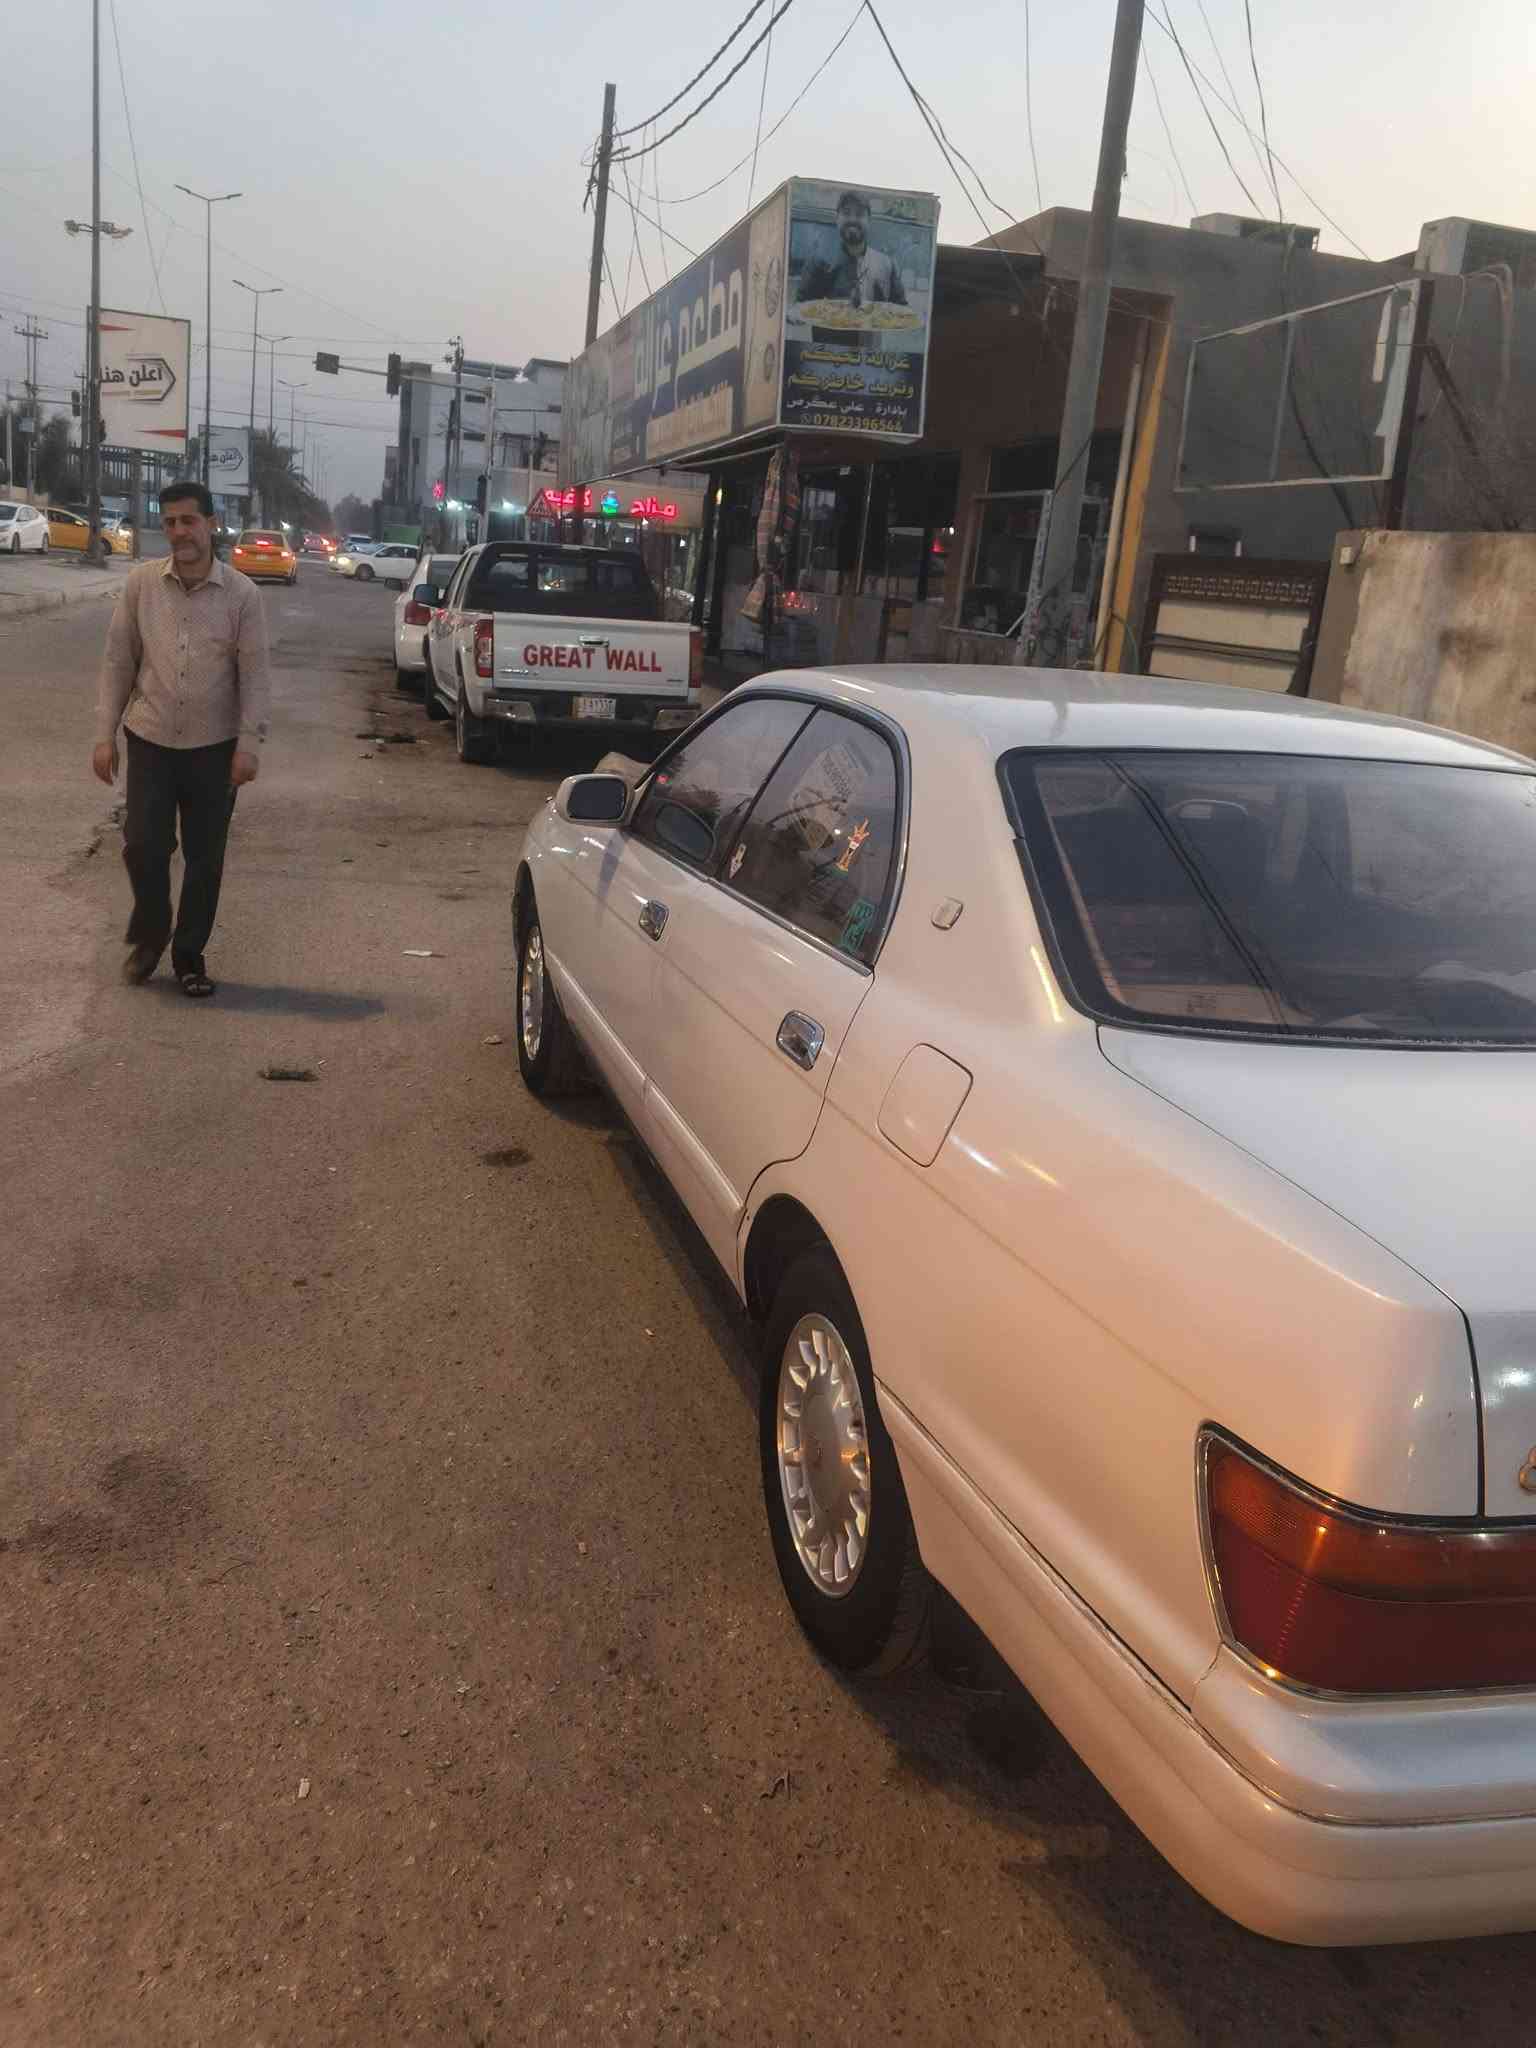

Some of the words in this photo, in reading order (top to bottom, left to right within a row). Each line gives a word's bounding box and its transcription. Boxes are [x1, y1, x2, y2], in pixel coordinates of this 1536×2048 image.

[129, 364, 163, 387] اعلن
[523, 644, 595, 669] GREAT
[606, 648, 662, 673] WALL
